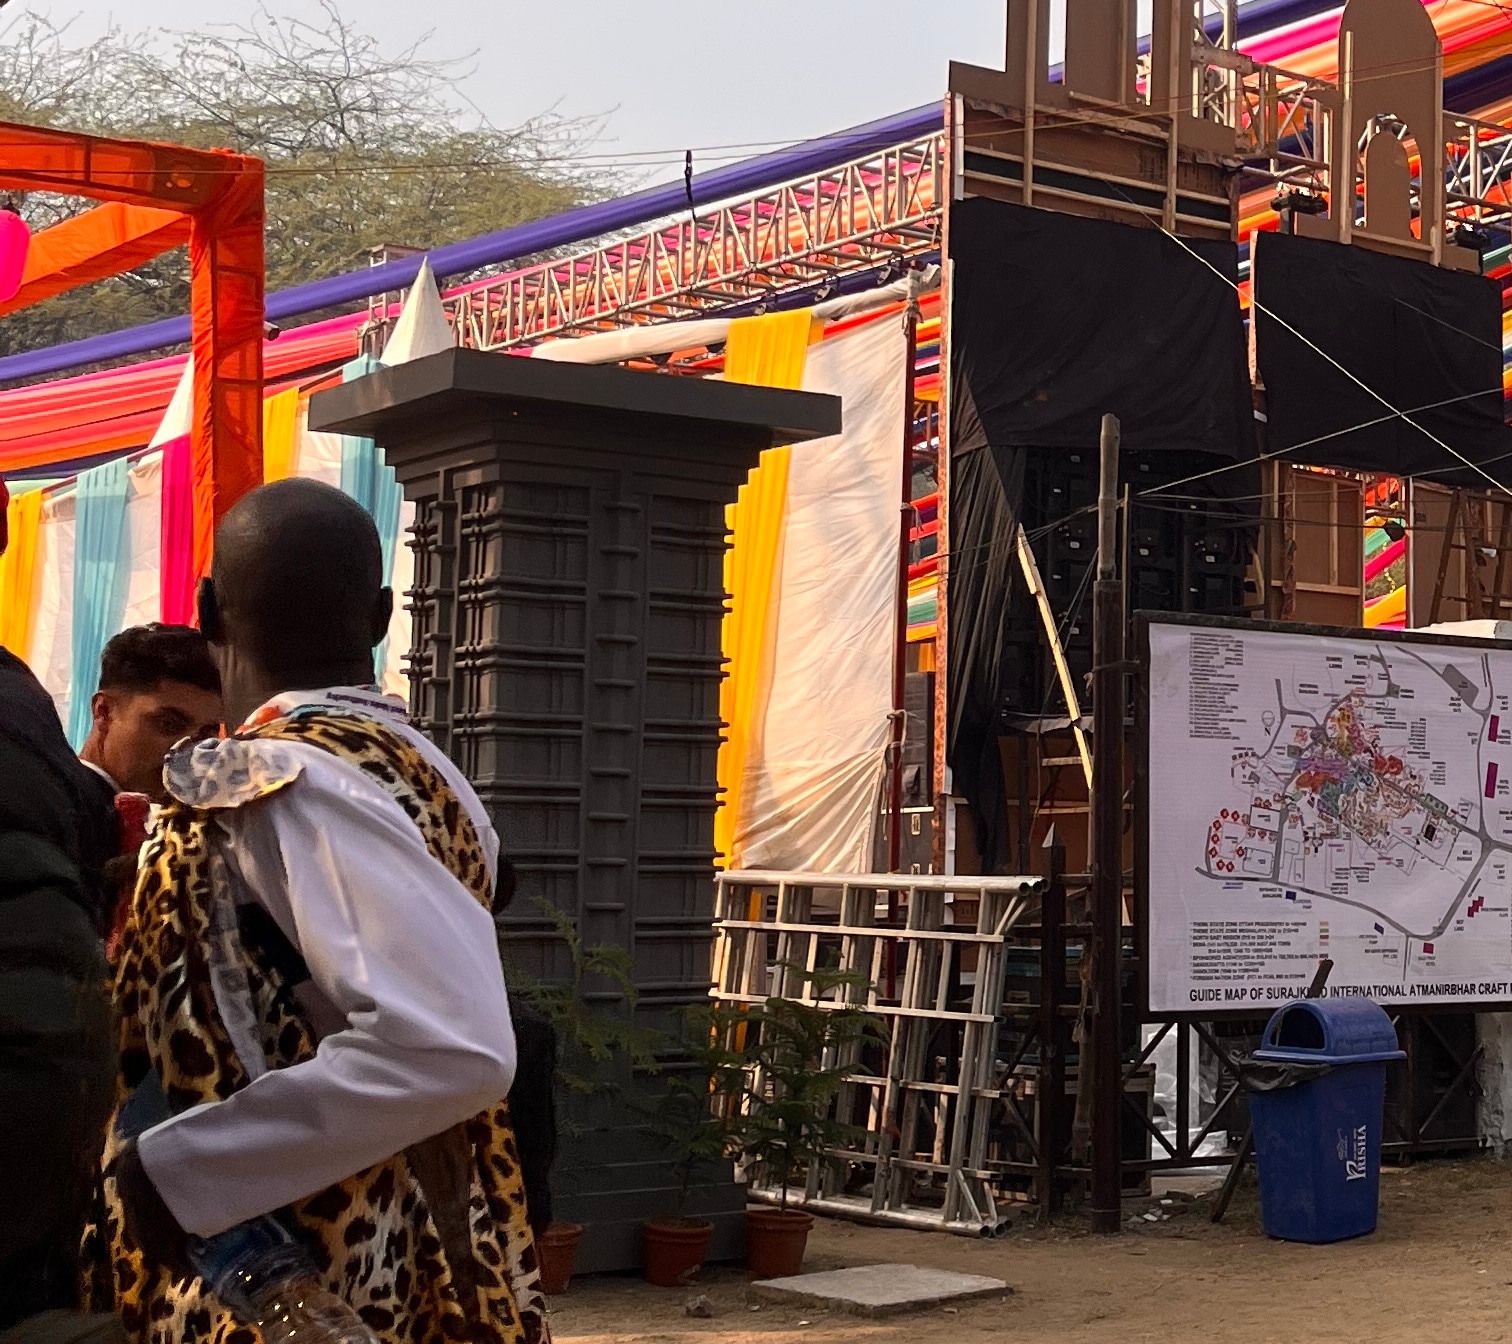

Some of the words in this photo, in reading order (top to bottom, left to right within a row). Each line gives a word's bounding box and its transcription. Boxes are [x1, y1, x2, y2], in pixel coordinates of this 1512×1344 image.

[1189, 989, 1222, 1002] GUIDE
[1224, 988, 1248, 1001] MAP
[1249, 987, 1264, 1000] OF
[1330, 984, 1407, 998] INTERNATIONAL
[1409, 983, 1476, 997] ATMANIRBHAR
[1478, 982, 1508, 995] CRAFT
